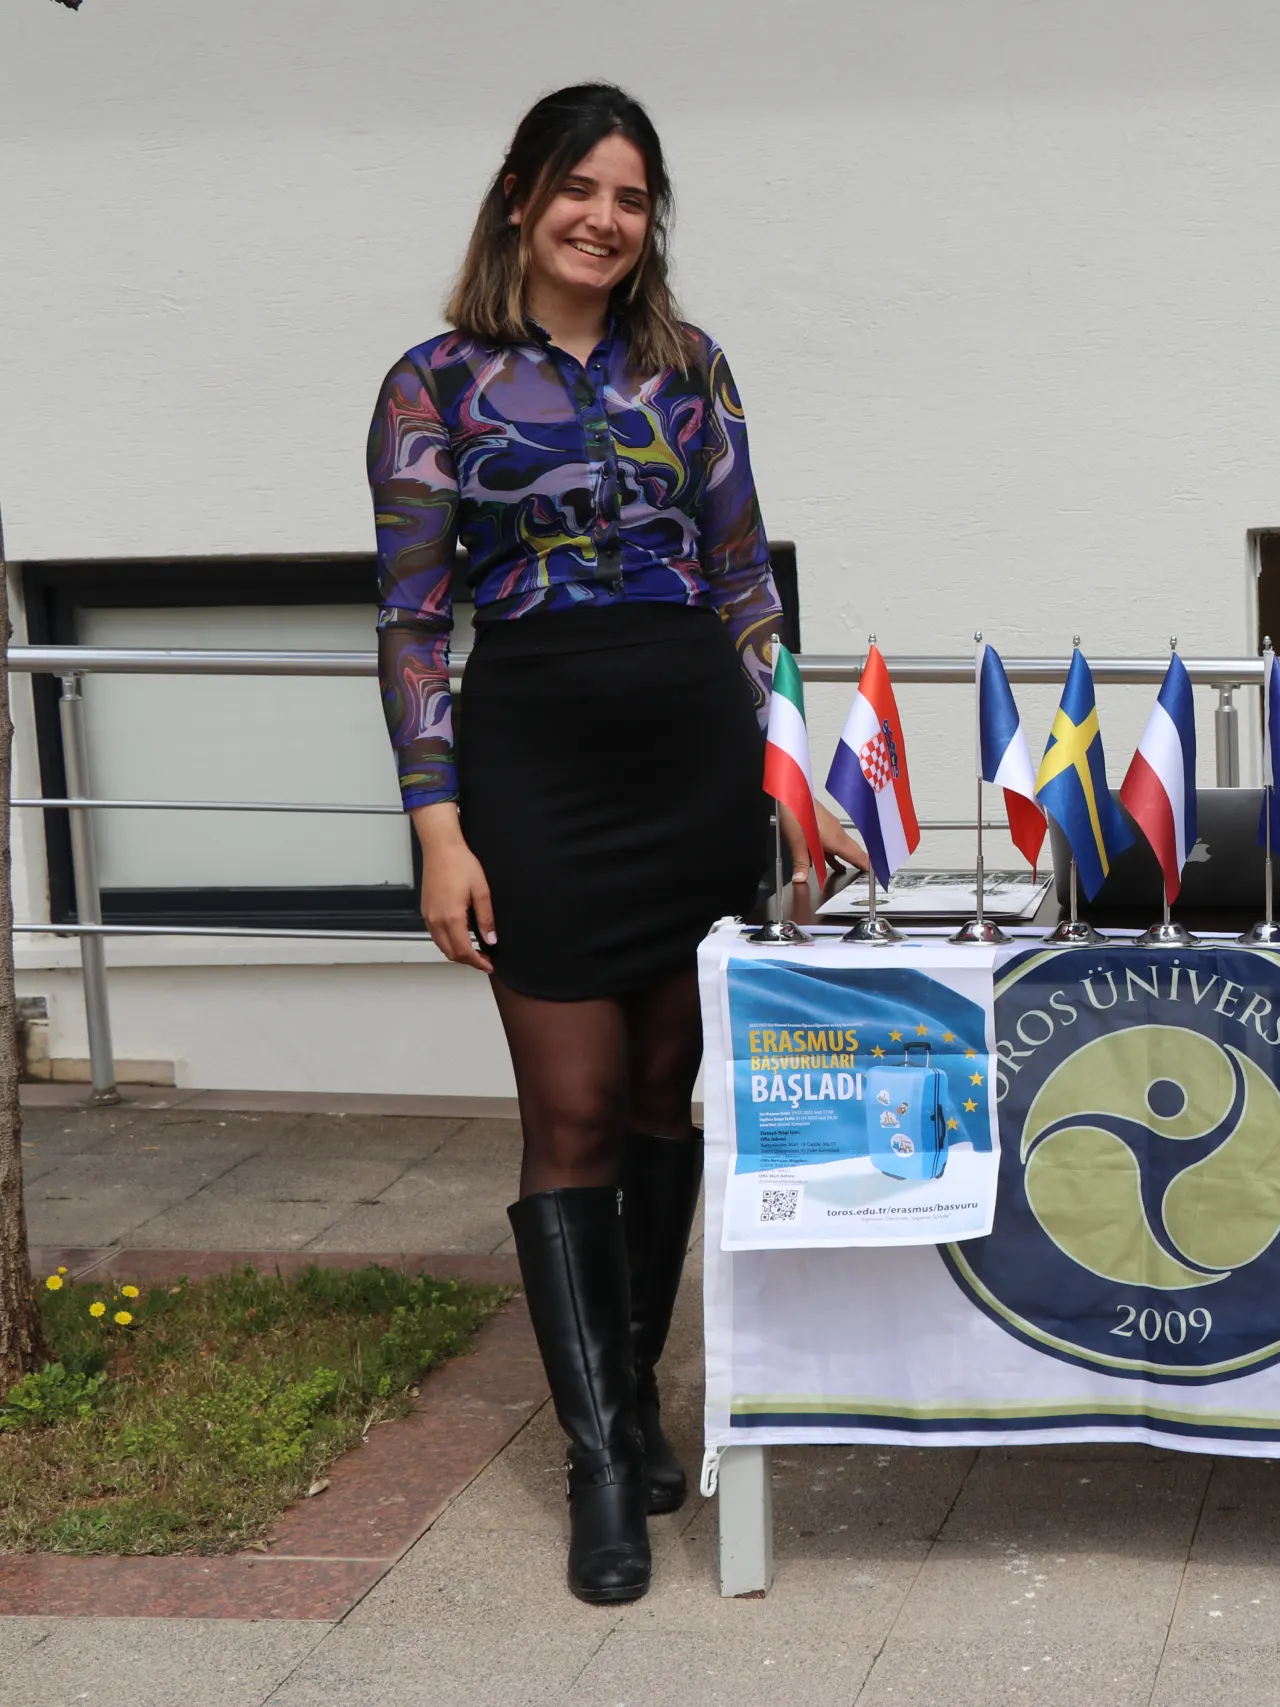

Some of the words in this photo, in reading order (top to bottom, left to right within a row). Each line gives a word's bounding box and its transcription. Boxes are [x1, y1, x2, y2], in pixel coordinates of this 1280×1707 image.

[749, 1030, 859, 1053] ERASMUS
[751, 1054, 855, 1074] BAŞVURULARI
[751, 1073, 863, 1109] BAŞLADI
[827, 1202, 978, 1217] toros.edu.tr/erasmus/basvuru
[1109, 1304, 1213, 1344] 2009
